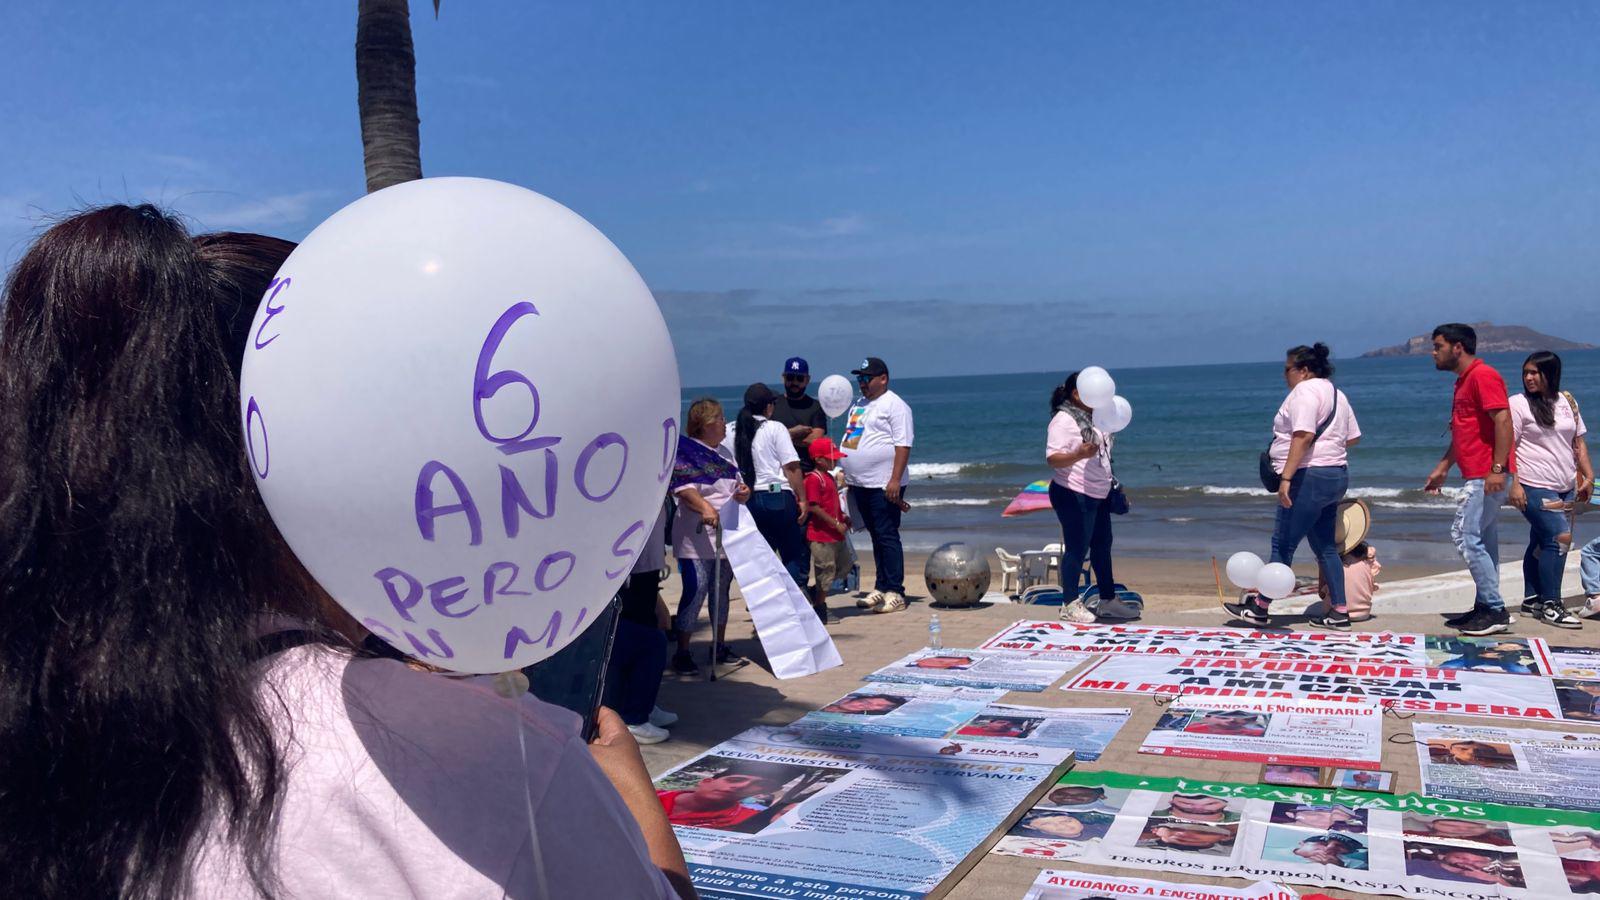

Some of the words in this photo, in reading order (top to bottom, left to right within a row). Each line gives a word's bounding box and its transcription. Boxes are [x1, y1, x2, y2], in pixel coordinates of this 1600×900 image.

[473, 301, 541, 444] 6
[414, 432, 629, 547] AÑO
[373, 551, 577, 623] PERO
[994, 642, 1036, 650] MI
[1043, 644, 1181, 655] FAMILIA
[1192, 649, 1249, 657] ME
[1258, 651, 1413, 664] ESPERA
[1166, 668, 1196, 676] A
[1207, 669, 1462, 692] REGRESAR
[1180, 676, 1211, 686] A
[1223, 678, 1286, 690] MI
[1298, 683, 1438, 700] CASA
[1079, 679, 1130, 690] MI
[1135, 683, 1294, 699] FAMILIA
[1306, 693, 1369, 704] ME
[1379, 698, 1557, 719] ESPERA
[1267, 704, 1374, 716] ENCONTRARLO
[969, 747, 1040, 757] SINALOA
[717, 750, 766, 760] KEVIN
[766, 756, 840, 767] ERNESTO
[844, 762, 929, 775] VERDUGO
[932, 769, 1039, 782] CERVANTES
[694, 867, 768, 882] referente
[792, 880, 830, 891] esta
[1109, 854, 1205, 869] TESOROS
[1211, 864, 1325, 881] PERDIDOS
[1331, 874, 1408, 893] HASTA
[737, 882, 759, 890] es
[761, 885, 801, 896] muy
[1047, 876, 1140, 894] AYUDANOS
[1143, 887, 1155, 896] A
